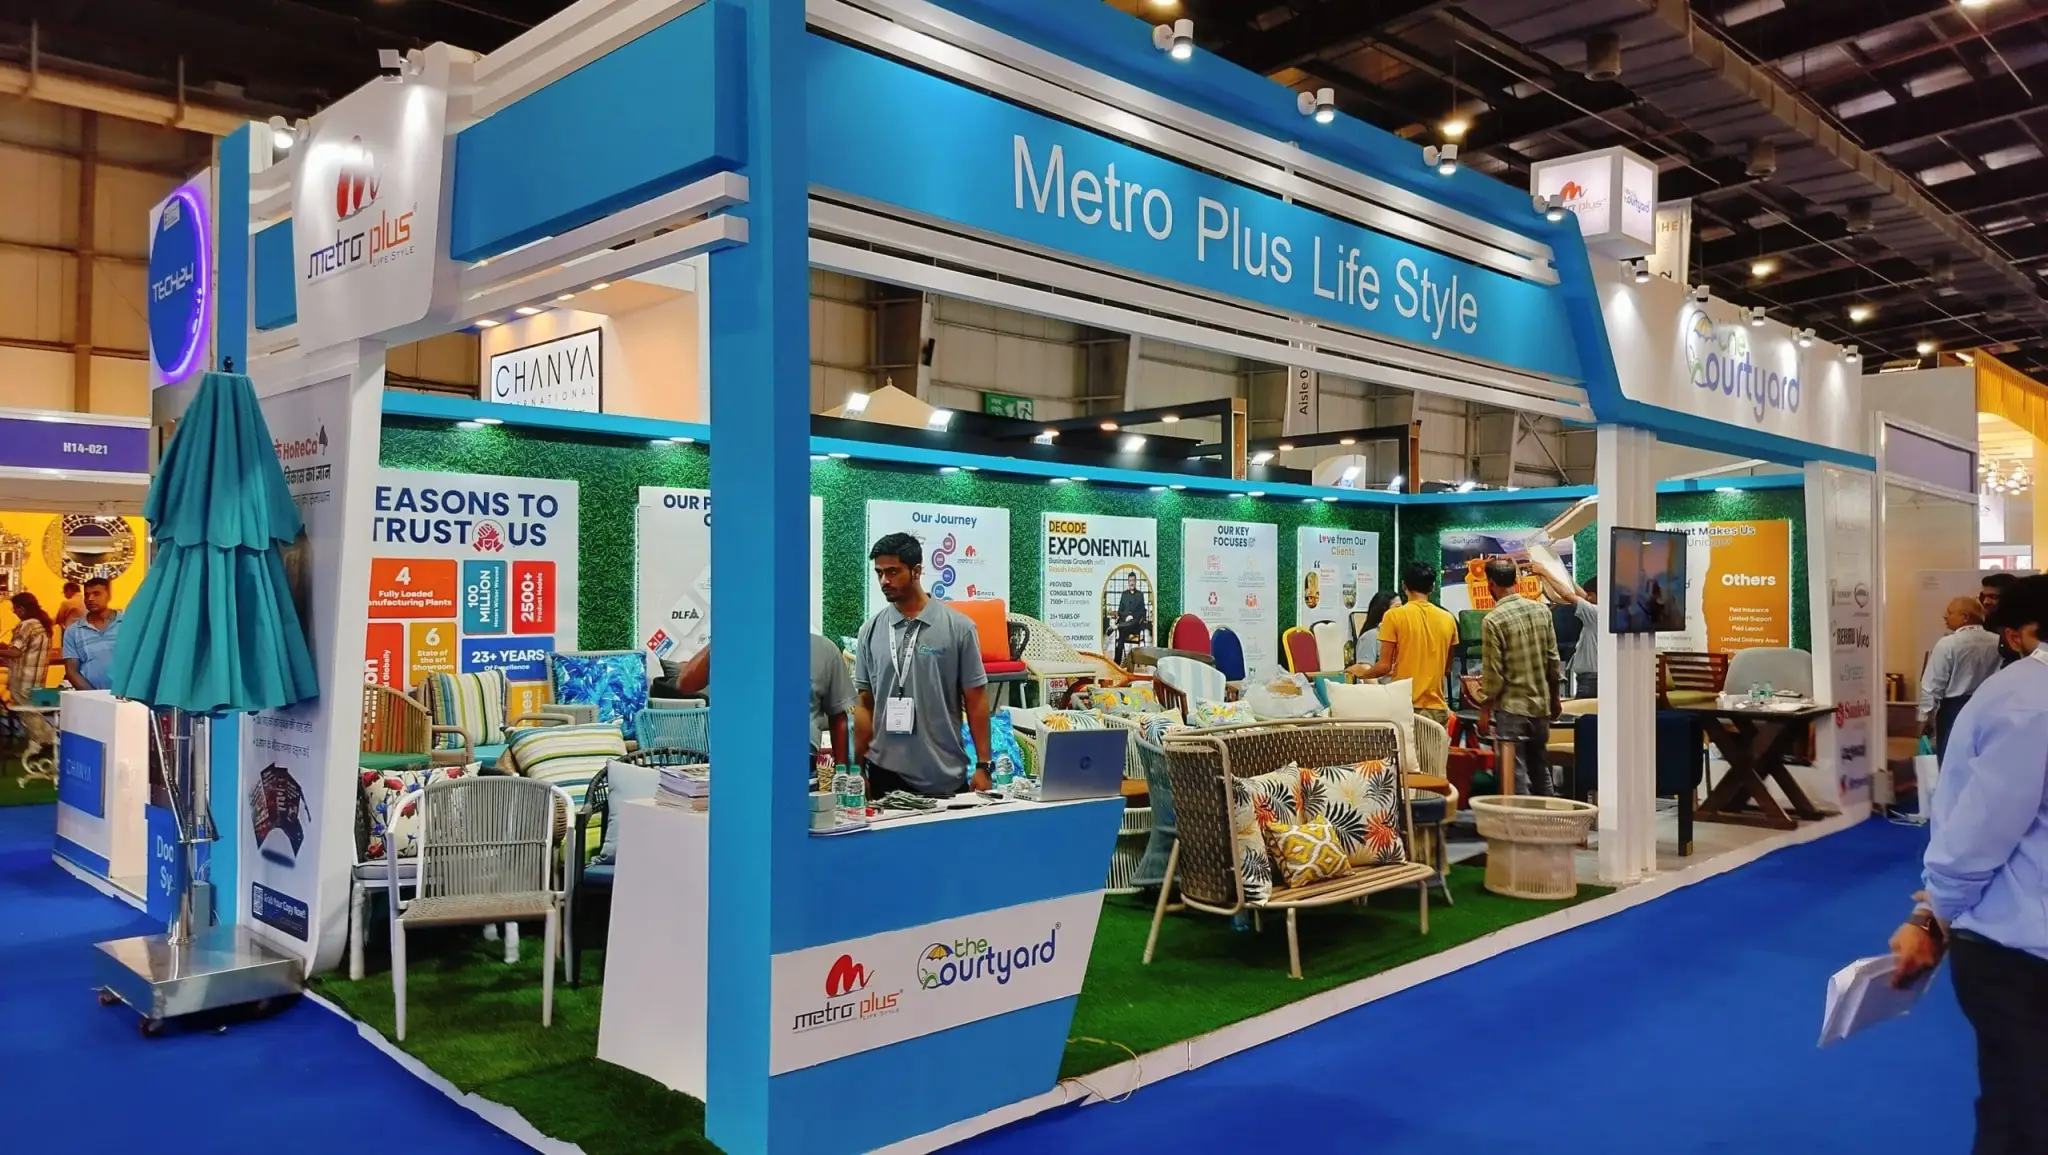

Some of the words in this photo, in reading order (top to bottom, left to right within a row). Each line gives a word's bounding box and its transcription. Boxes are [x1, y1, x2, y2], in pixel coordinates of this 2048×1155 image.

[1656, 220, 1679, 232] HE
[308, 229, 365, 279] metro
[370, 210, 413, 264] plus
[1013, 135, 1173, 240] Metro
[1197, 196, 1293, 283] Plus
[1313, 236, 1380, 311] Life
[1394, 258, 1478, 340] Style
[152, 262, 194, 302] TECH24
[1660, 270, 1672, 279] 2
[1298, 382, 1309, 415] Aisle
[63, 442, 109, 455] H14-021
[283, 438, 318, 460] HoReCa
[375, 486, 510, 516] EASONS
[518, 494, 559, 518] TO
[663, 494, 700, 509] OUR
[912, 512, 932, 522] Our
[935, 513, 977, 528] Journey
[1049, 521, 1087, 534] DECODE
[508, 522, 547, 547] US
[1217, 525, 1234, 535] OUR
[1235, 526, 1250, 536] KEY
[1698, 526, 1738, 536] Makes
[1740, 525, 1755, 535] Us
[1049, 537, 1150, 558] EXPONENTIAL
[1213, 537, 1248, 548] FOCUSES
[1336, 534, 1353, 544] from
[1354, 536, 1367, 546] Our
[1331, 546, 1356, 557] Clients
[395, 566, 411, 586] 4
[1721, 573, 1776, 586] Others
[379, 590, 400, 599] Fully
[401, 590, 433, 598] Loaded
[468, 584, 479, 608] 100
[480, 570, 491, 622] MILLION
[520, 573, 535, 622] 2500+
[368, 598, 424, 608] anufacturing
[1475, 599, 1496, 609] BUSIN
[671, 610, 690, 619] DLF
[425, 627, 441, 646] 6
[472, 651, 497, 663] 23+
[499, 649, 545, 662] YEARS
[383, 649, 391, 680] Globally
[954, 937, 988, 957] the
[792, 1002, 855, 1030] metro
[860, 992, 899, 1018] plus
